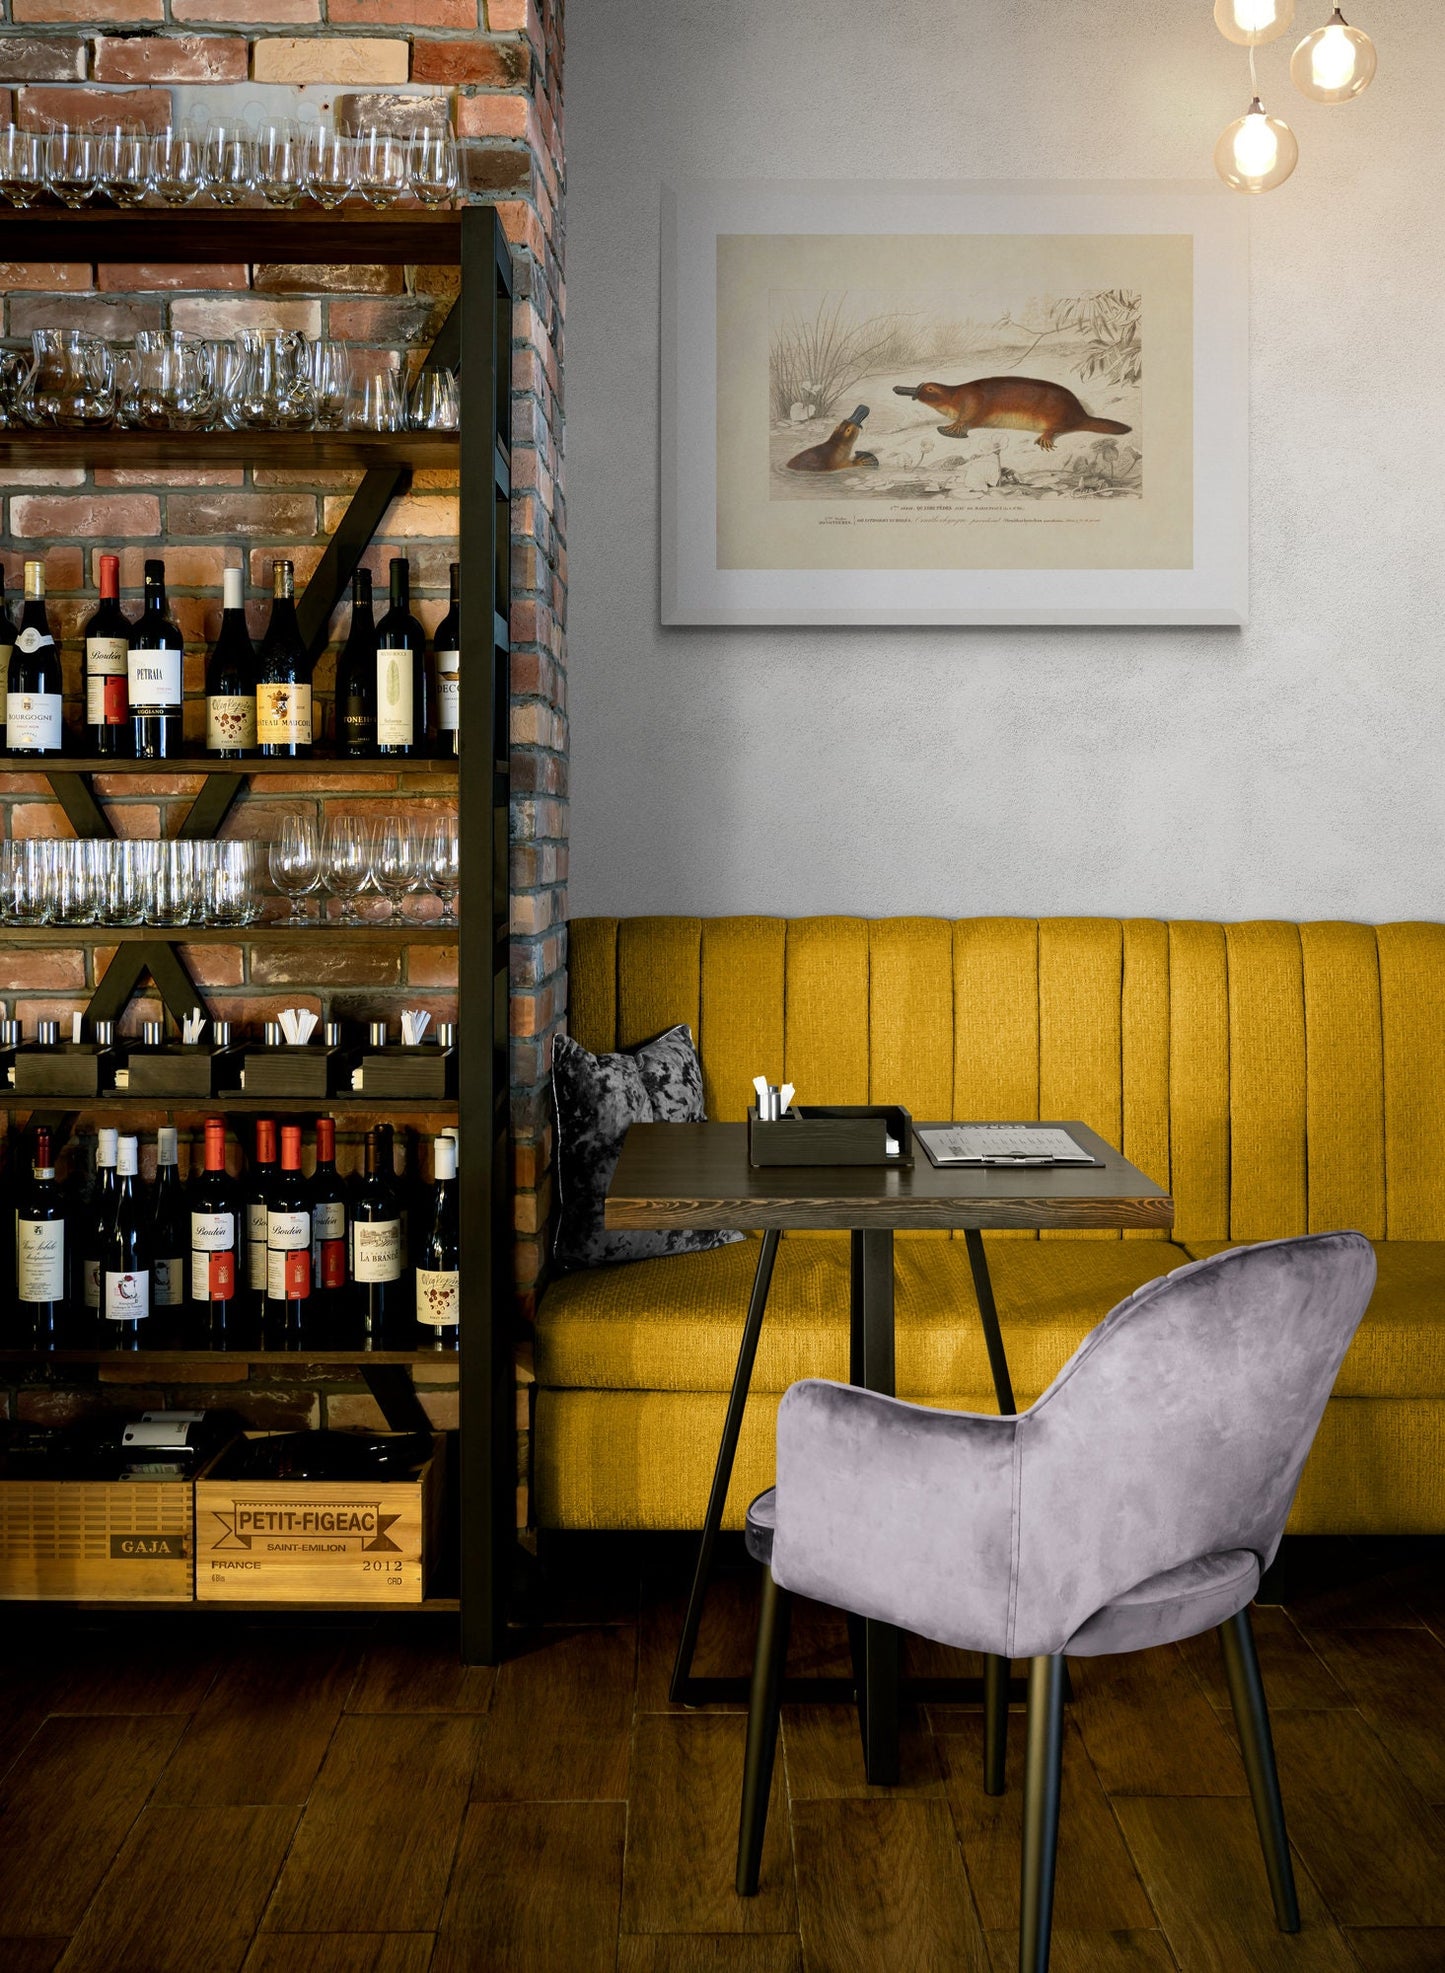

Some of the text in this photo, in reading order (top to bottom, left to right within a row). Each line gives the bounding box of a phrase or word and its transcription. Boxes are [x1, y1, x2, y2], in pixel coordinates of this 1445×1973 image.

[437, 683, 459, 693] DEC
[8, 713, 53, 721] BOURGOGNE
[196, 1226, 227, 1236] Bordón
[272, 1225, 303, 1235] Bordón
[239, 1511, 376, 1531] PETIT-FIGEAC
[121, 1540, 172, 1553] GAJA
[267, 1543, 347, 1552] SAINT-EMILION
[211, 1560, 262, 1570] FRANCE
[362, 1560, 403, 1571] 2012
